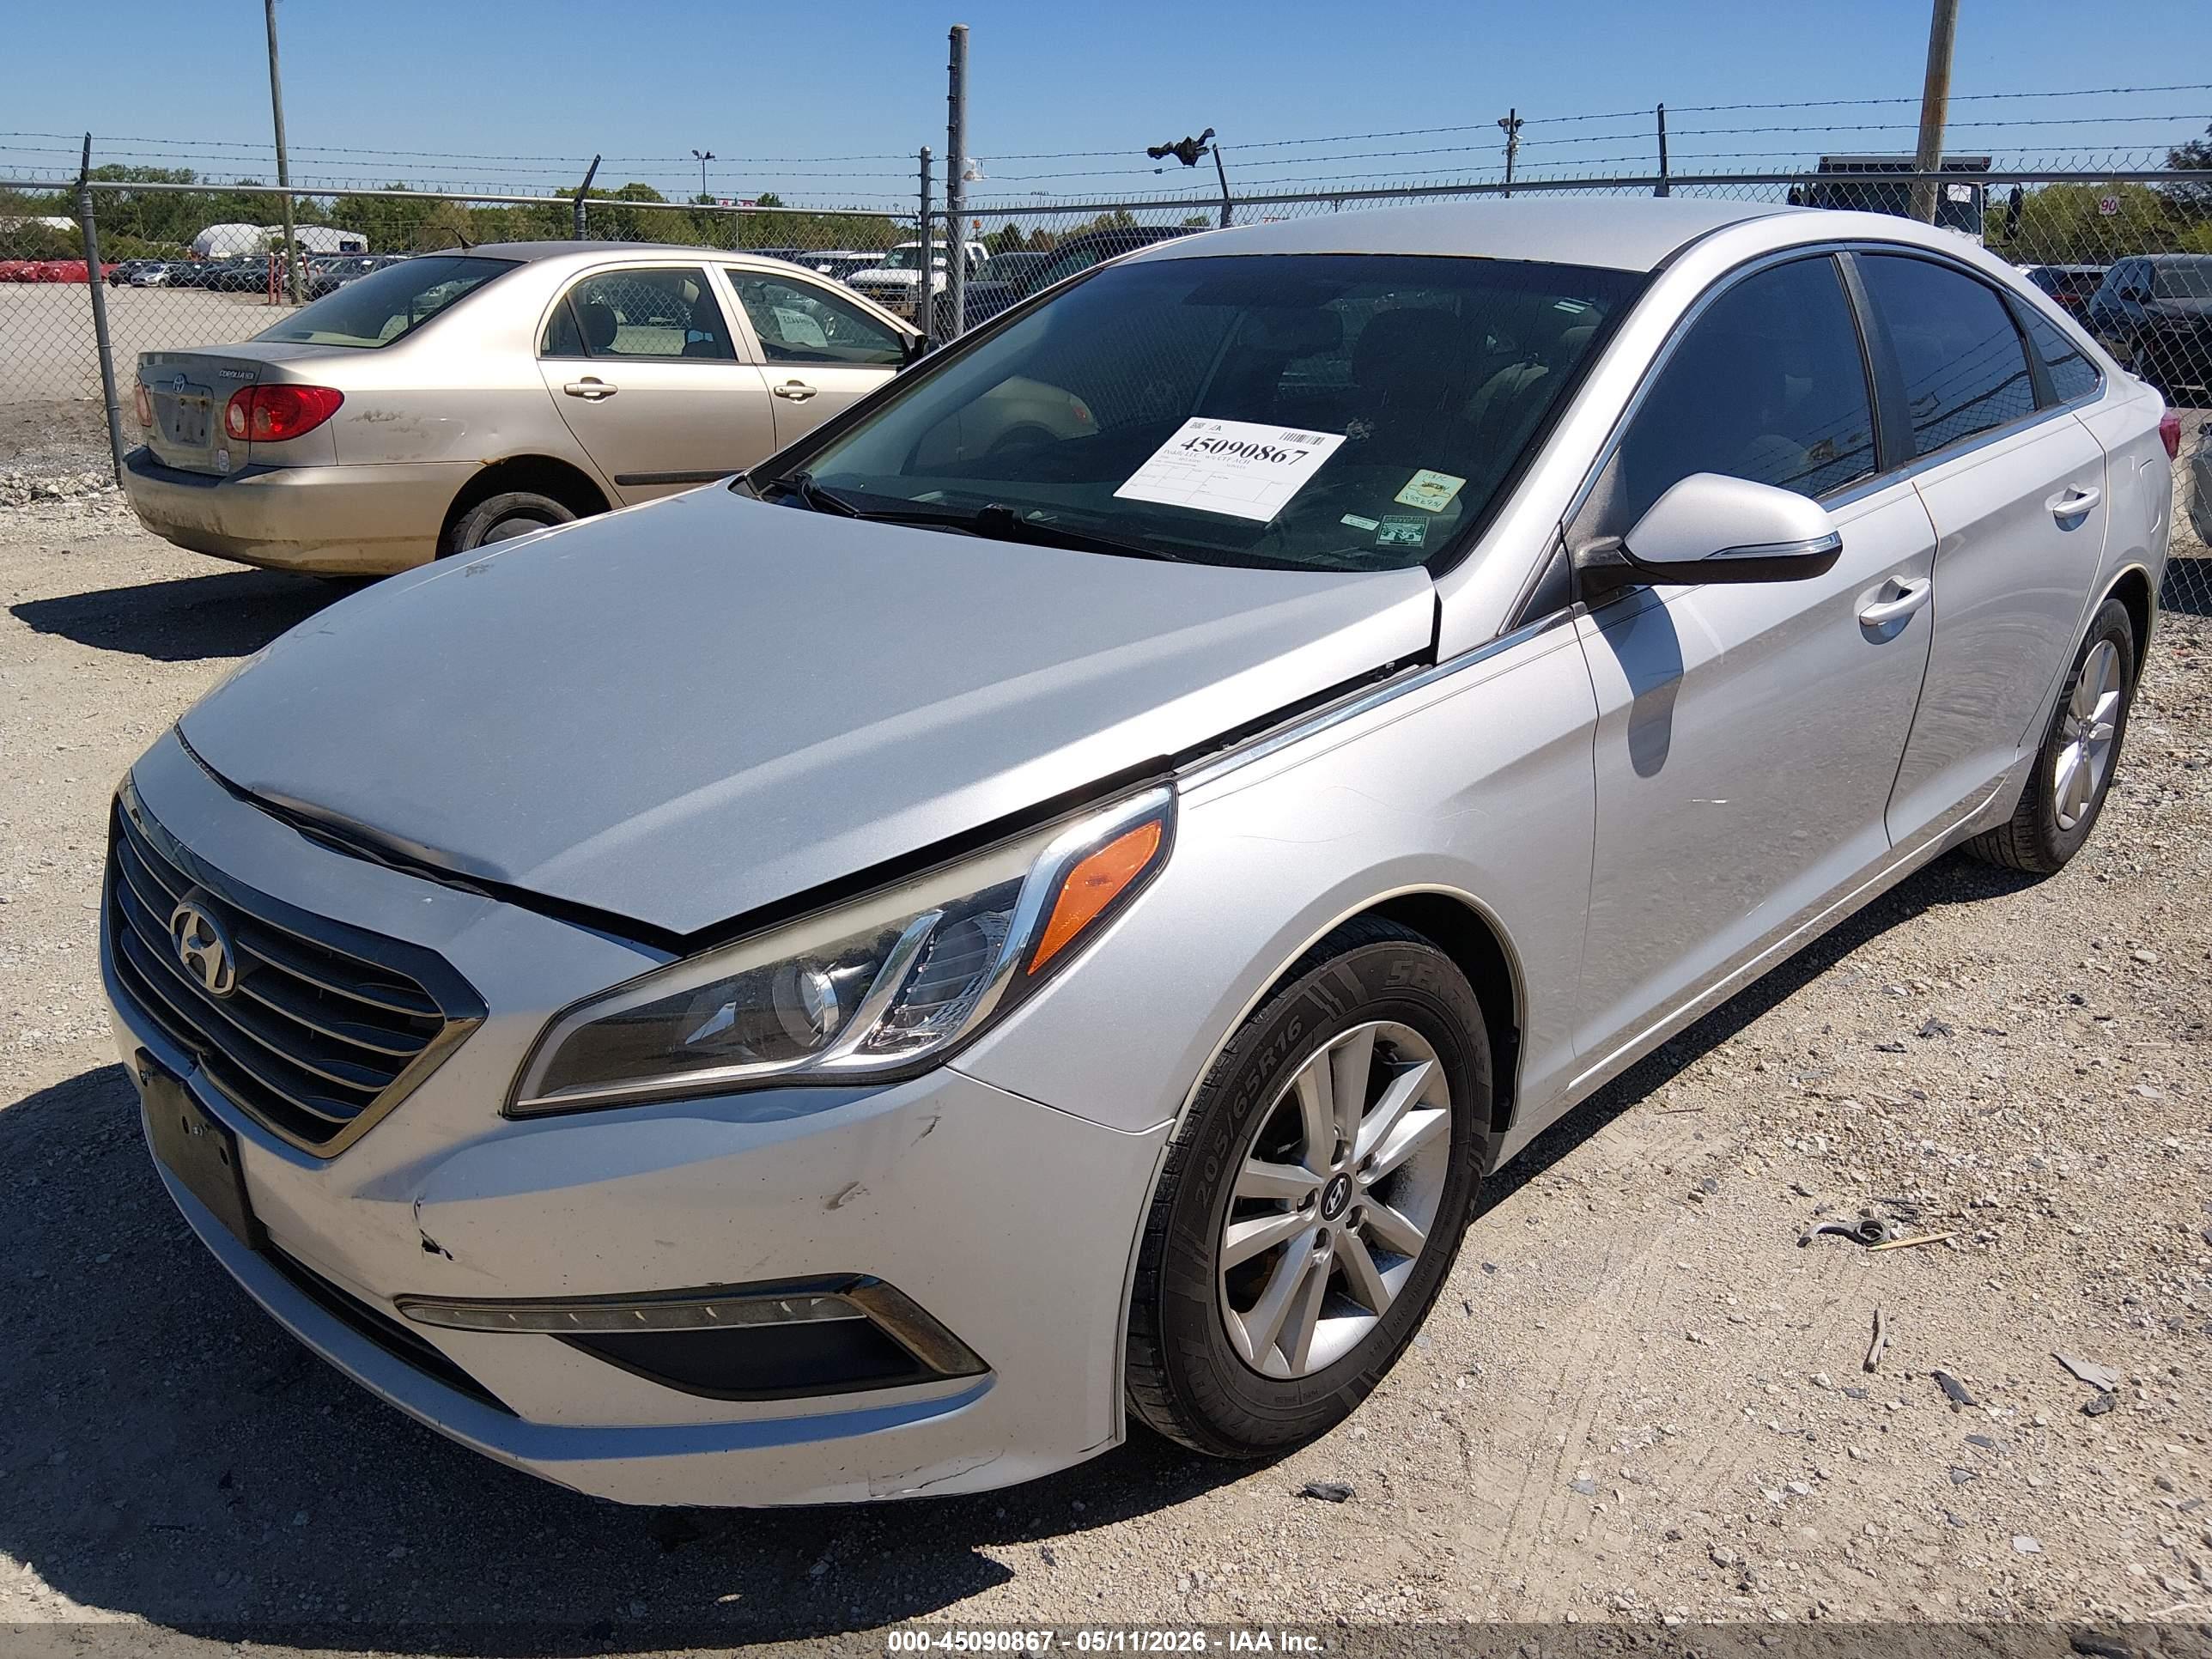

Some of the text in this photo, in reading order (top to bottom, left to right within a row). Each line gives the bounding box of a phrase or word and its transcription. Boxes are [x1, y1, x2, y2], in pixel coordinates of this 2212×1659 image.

[2101, 199, 2117, 211] 90
[1181, 436, 1310, 465] 45090867
[1194, 1014, 1305, 1210] 205/65R16
